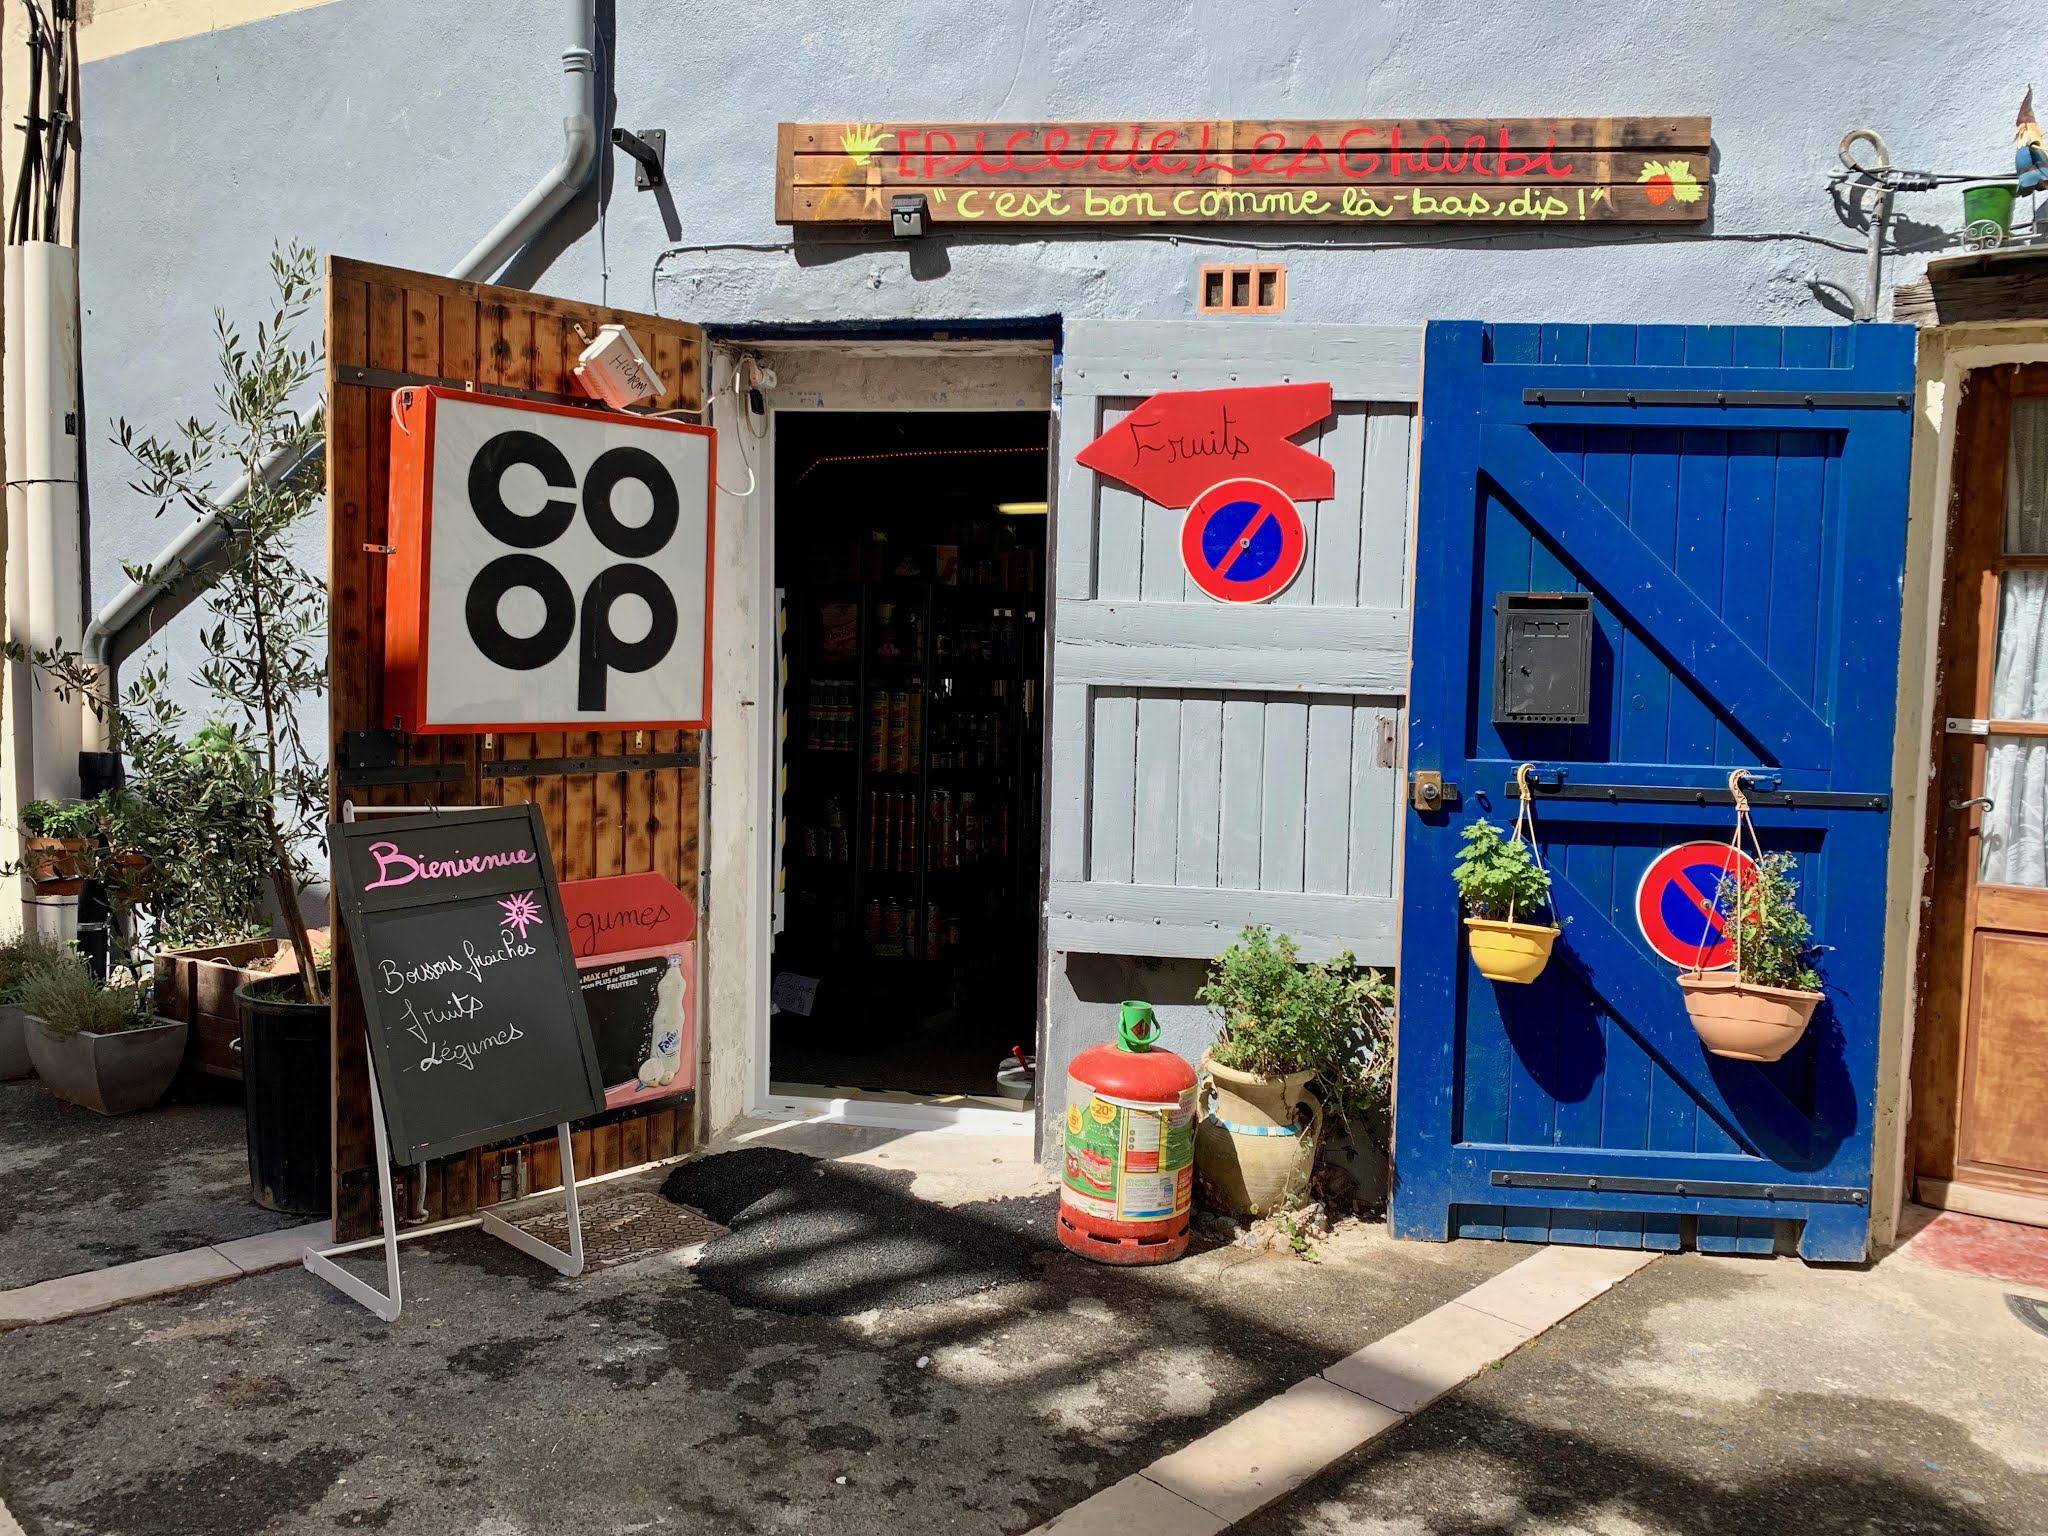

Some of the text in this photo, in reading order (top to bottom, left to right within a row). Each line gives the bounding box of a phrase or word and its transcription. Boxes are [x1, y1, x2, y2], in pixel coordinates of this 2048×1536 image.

[1085, 188, 1165, 217] bon
[1173, 189, 1331, 217] comme
[1129, 405, 1249, 467] Fruits
[365, 841, 536, 891] Bienvenue
[566, 904, 671, 957] gumes
[378, 954, 463, 995] Boissons
[582, 972, 601, 983] MAX
[609, 966, 626, 976] FUN
[595, 978, 612, 987] PLUS
[619, 966, 658, 981] SENSATIONS
[400, 992, 484, 1044] fruits
[420, 1023, 524, 1071] Légumes
